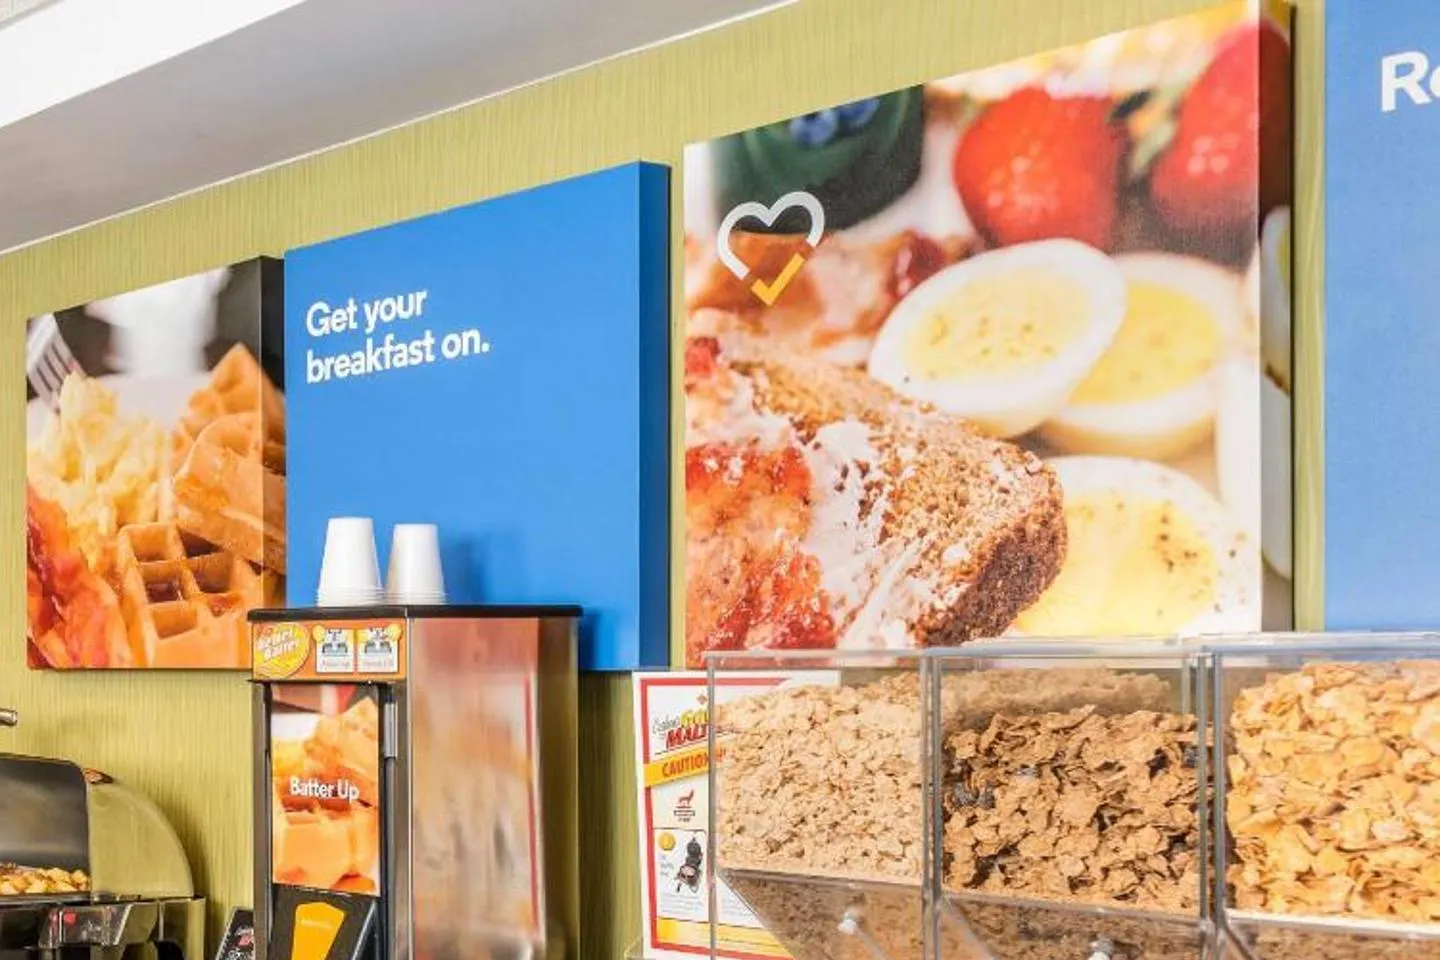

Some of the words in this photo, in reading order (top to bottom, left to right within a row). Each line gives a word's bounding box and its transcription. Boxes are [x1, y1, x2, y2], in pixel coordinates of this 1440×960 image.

[306, 298, 358, 337] Get
[363, 289, 429, 334] your
[306, 329, 436, 384] breakfast
[441, 327, 490, 359] on.
[289, 776, 335, 798] Batter
[337, 779, 360, 804] Up
